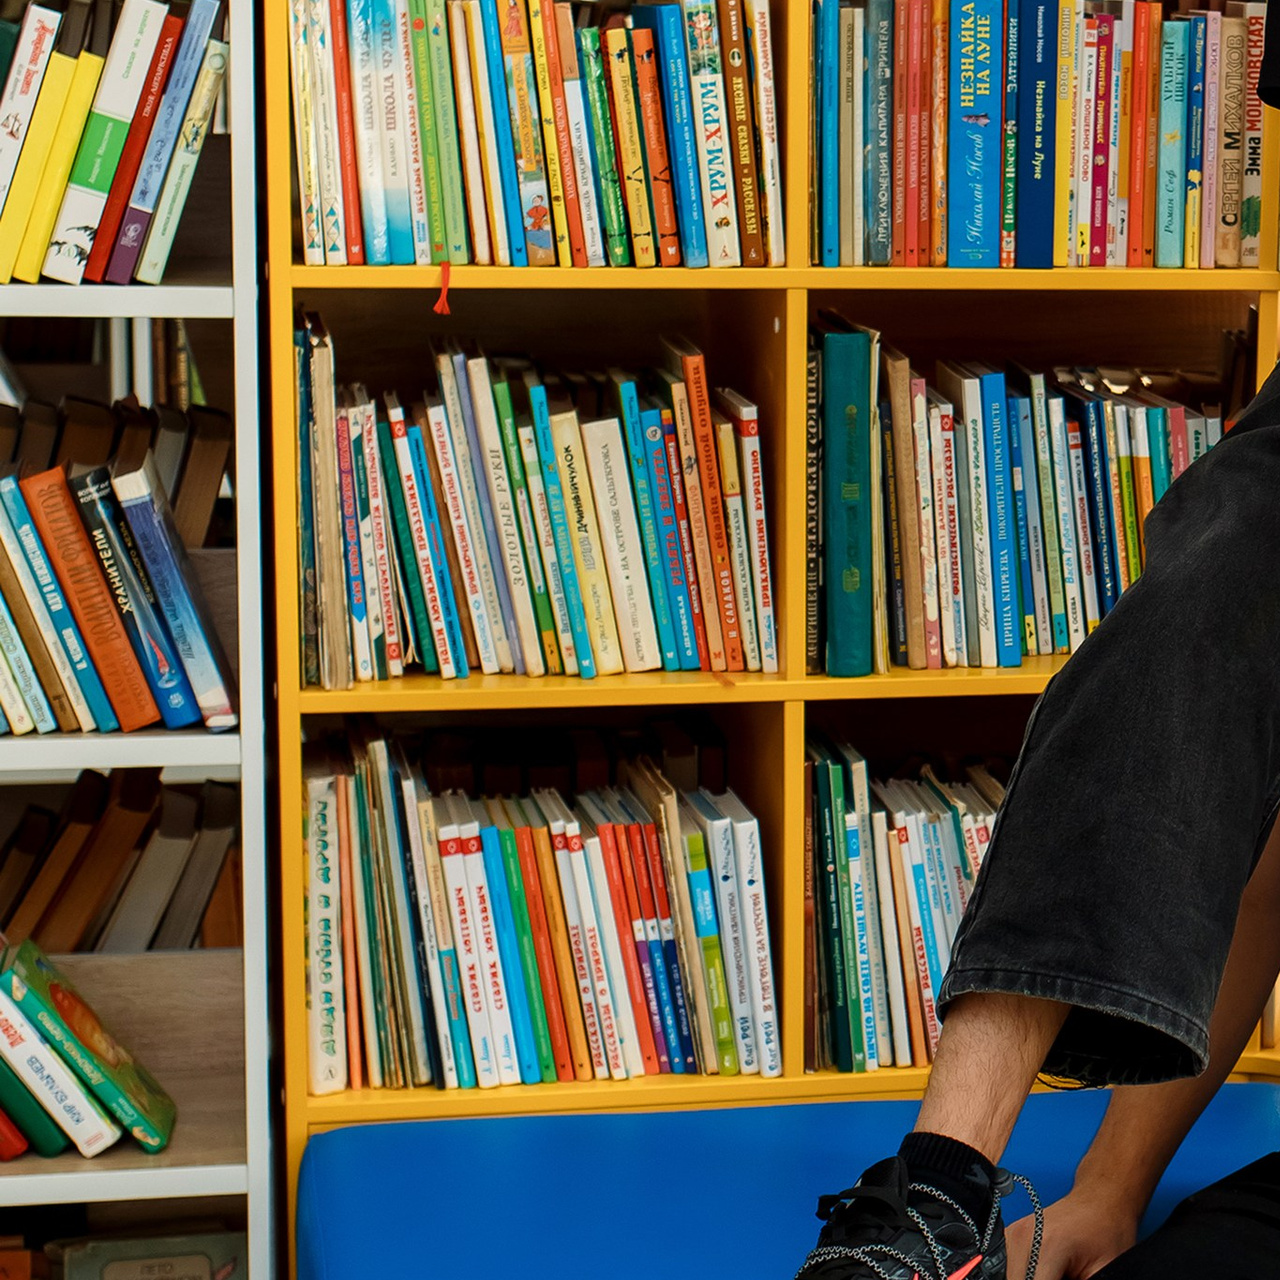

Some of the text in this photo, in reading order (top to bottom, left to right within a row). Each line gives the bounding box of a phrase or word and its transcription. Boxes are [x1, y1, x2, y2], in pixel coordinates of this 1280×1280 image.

[148, 36, 174, 96] АНТАРКТИДА
[957, 1, 975, 108] НЕЗНАЙКА
[976, 14, 991, 96] НА ЛУНЕ
[1032, 5, 1046, 180] Николай Носов Незнайка на Луне
[1162, 40, 1176, 103] ХРАБРЫЙ
[1174, 52, 1186, 104] ЦВЕТОК
[384, 73, 397, 131] ШКОЛА
[699, 81, 729, 210] ХРУМ-ХРУМ
[1081, 98, 1093, 182] ВОЛШЕБНОЕ СЛОВО
[1220, 34, 1244, 227] СЕРГЕЙ МИХАЛКОВ
[737, 125, 757, 235] СКАЗКИ РАССКАЗЫ
[876, 84, 890, 243] ПРИКЛЮЧЕНИЯ КАПИТАНА
[964, 130, 984, 245] Николай Носов
[1244, 136, 1261, 176] Эмма
[1163, 169, 1177, 235] Роман Сеф
[488, 447, 507, 493] РУКИ
[36, 482, 81, 563] ФРЕГАТОВ
[499, 500, 525, 587] ЗОЛОТЫЕ
[652, 448, 683, 587] РЕБЯТА ЗВЕРЯТА
[709, 496, 735, 625] СЛАДКОВ сказки
[751, 449, 772, 609] ПРИКЛЮЧЕНИЯ БУРАТИНО
[943, 438, 960, 596] ФАНТАСТИЧЕСКИЕ РАССКАЗЫ
[991, 402, 1014, 647] ИРИНА КИРЕЕВА ПОКОРИТЕЛИ ПРОСТРАНСТВ
[91, 527, 133, 614] ХРАНИТЕЛИ
[454, 887, 473, 956] ХОТТАБЫЧ
[474, 885, 495, 953] ХОТТАБЫЧ
[914, 926, 930, 990] РАССКАЗЫ
[569, 924, 604, 1069] РАССКАЗЫ ПРИРОДЕ
[587, 926, 621, 1070] РАССКАЗЫ ПРИРОДЕ
[737, 1016, 752, 1041] РОЙ
[856, 915, 876, 1061] НИЧЕГО НА СВЕТЕ ЛУЧШЕ
[762, 1020, 776, 1046] РОЙ
